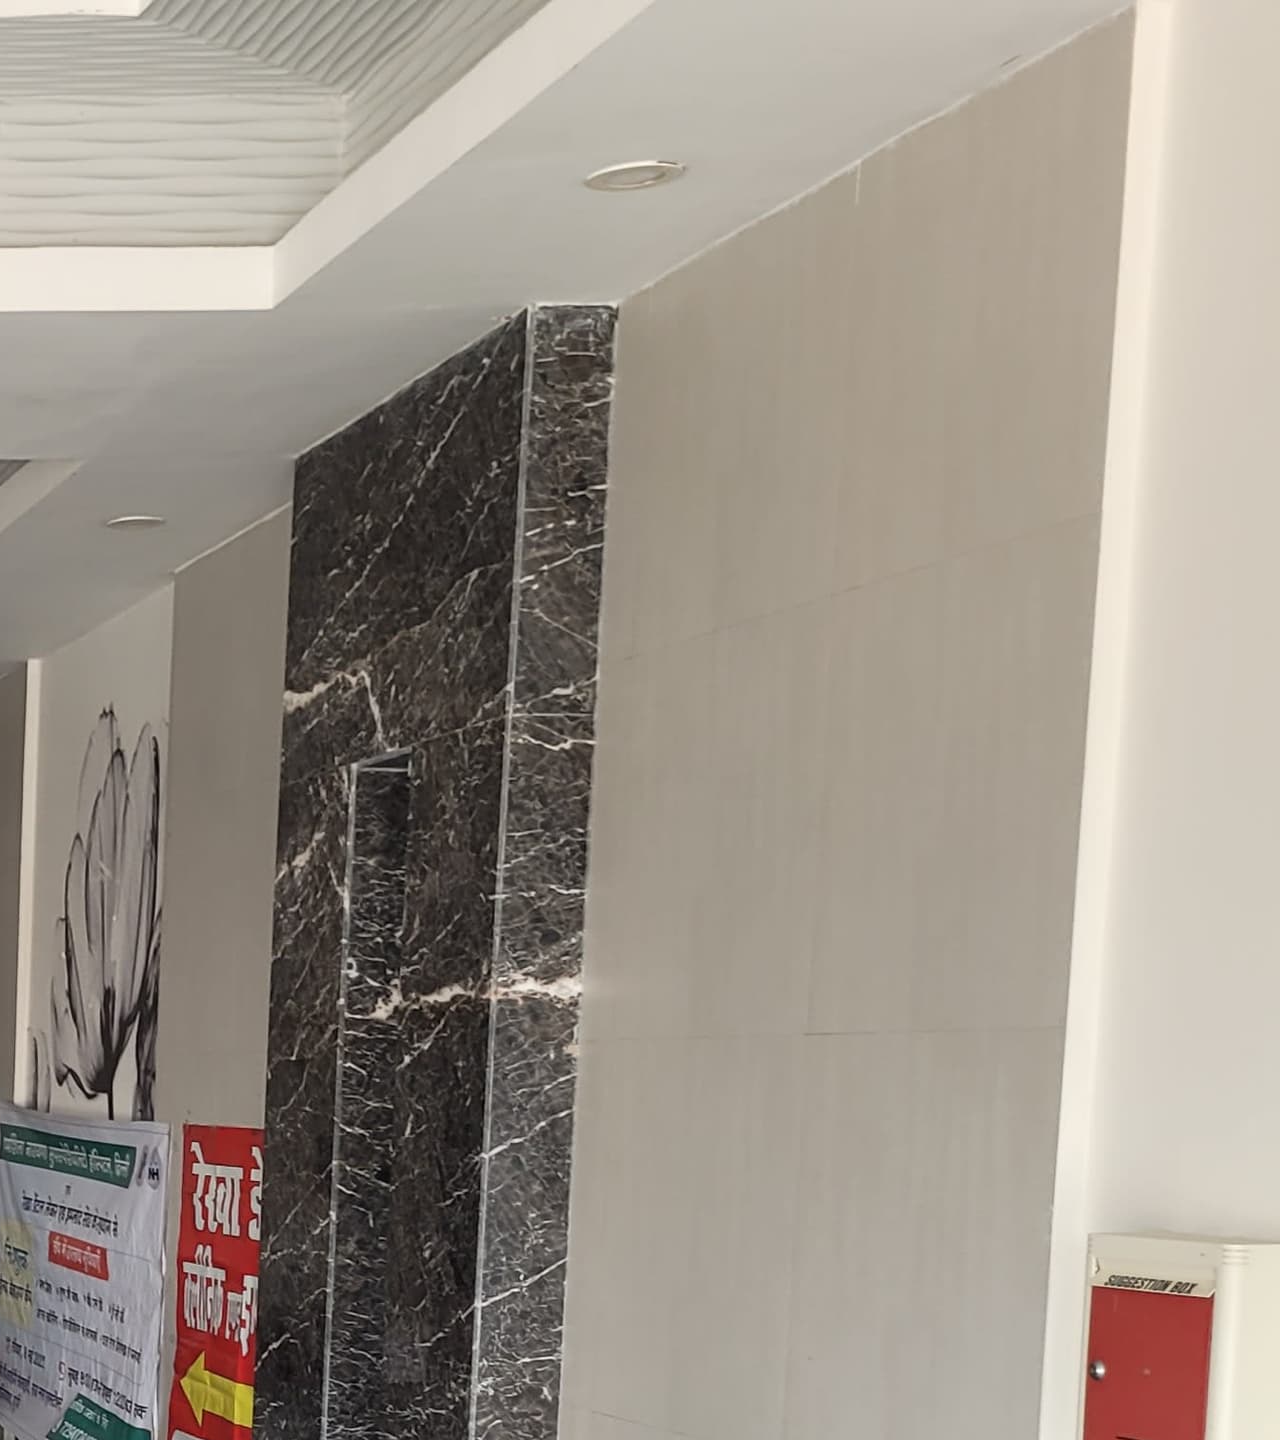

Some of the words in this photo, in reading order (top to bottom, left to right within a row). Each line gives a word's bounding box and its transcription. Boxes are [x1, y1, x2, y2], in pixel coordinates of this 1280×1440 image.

[148, 1167, 159, 1181] NH
[191, 1141, 244, 1237] रेखा
[1104, 1274, 1173, 1291] SUGGESTION
[1169, 1280, 1199, 1294] BOX
